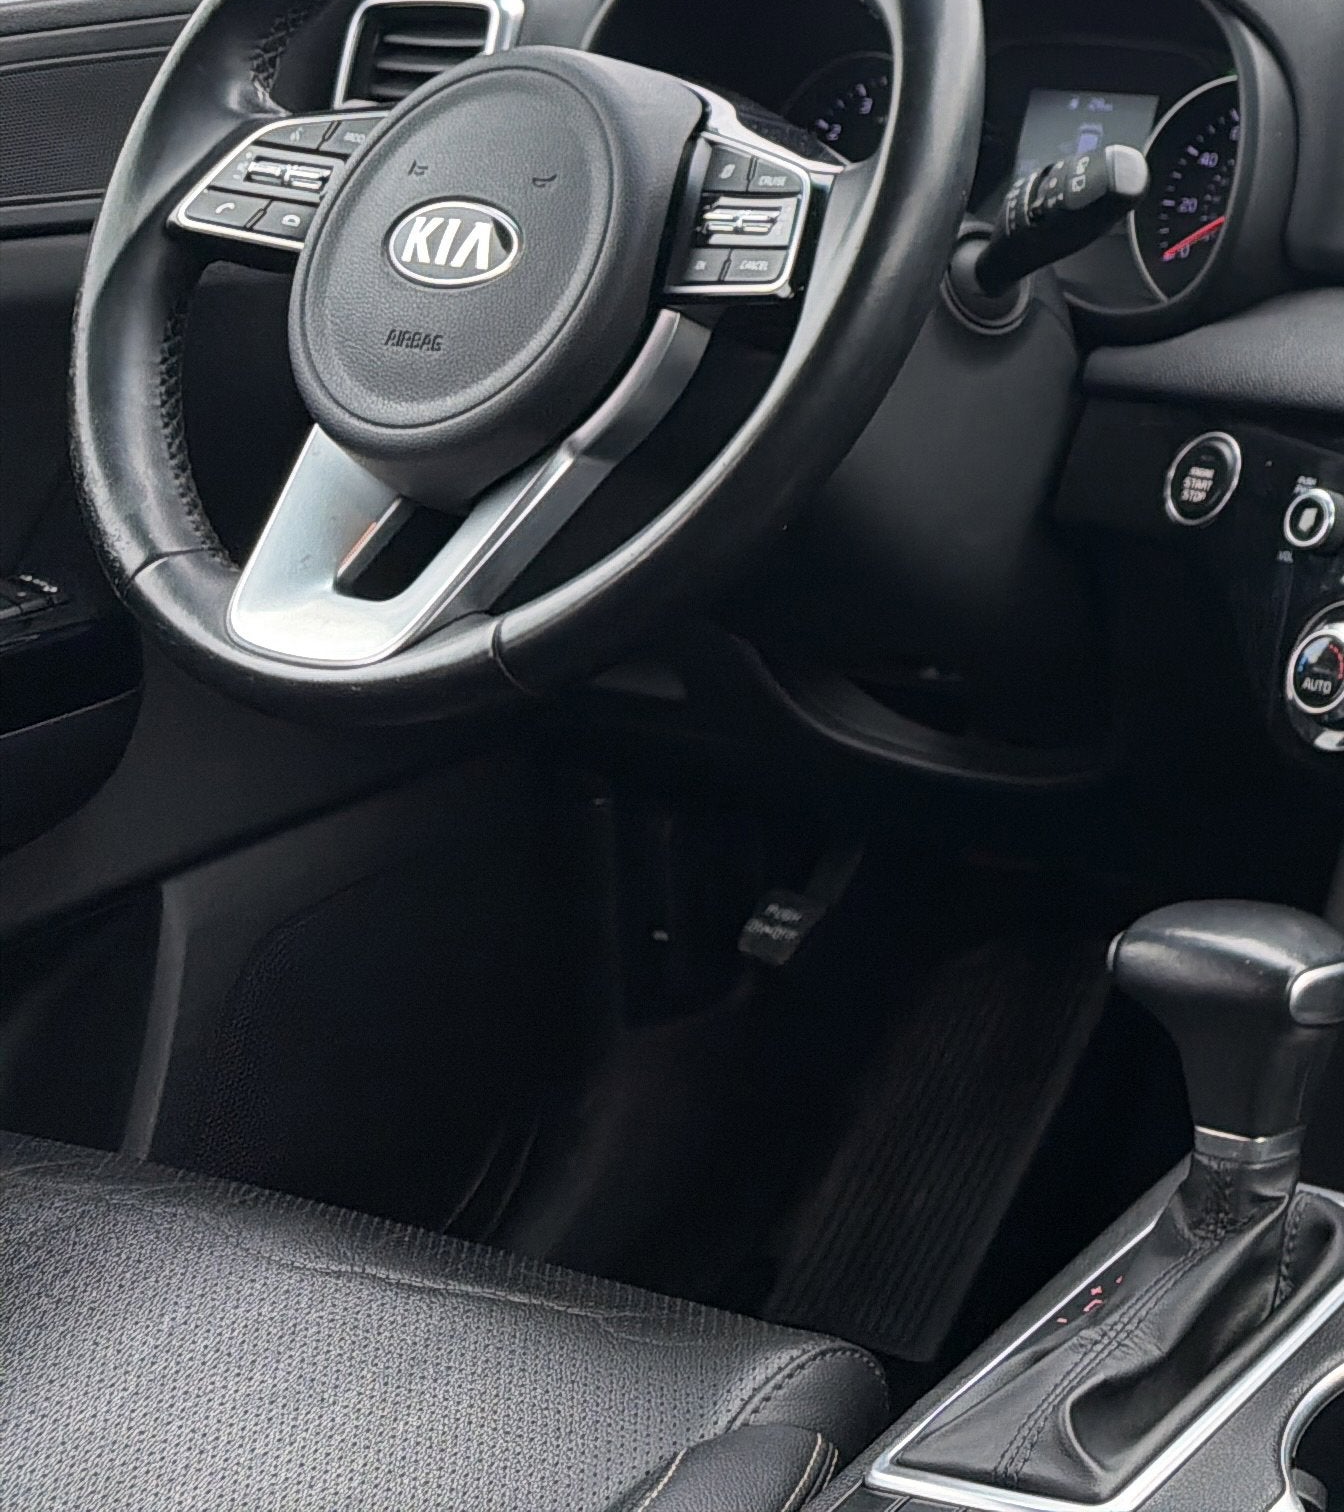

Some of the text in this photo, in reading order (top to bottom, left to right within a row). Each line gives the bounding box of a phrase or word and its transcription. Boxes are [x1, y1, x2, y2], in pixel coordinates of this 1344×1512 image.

[401, 216, 492, 270] KIA
[384, 328, 443, 352] AIRBAG
[1182, 476, 1214, 491] START
[1181, 488, 1207, 503] STOP
[1301, 676, 1332, 695] AUTO
